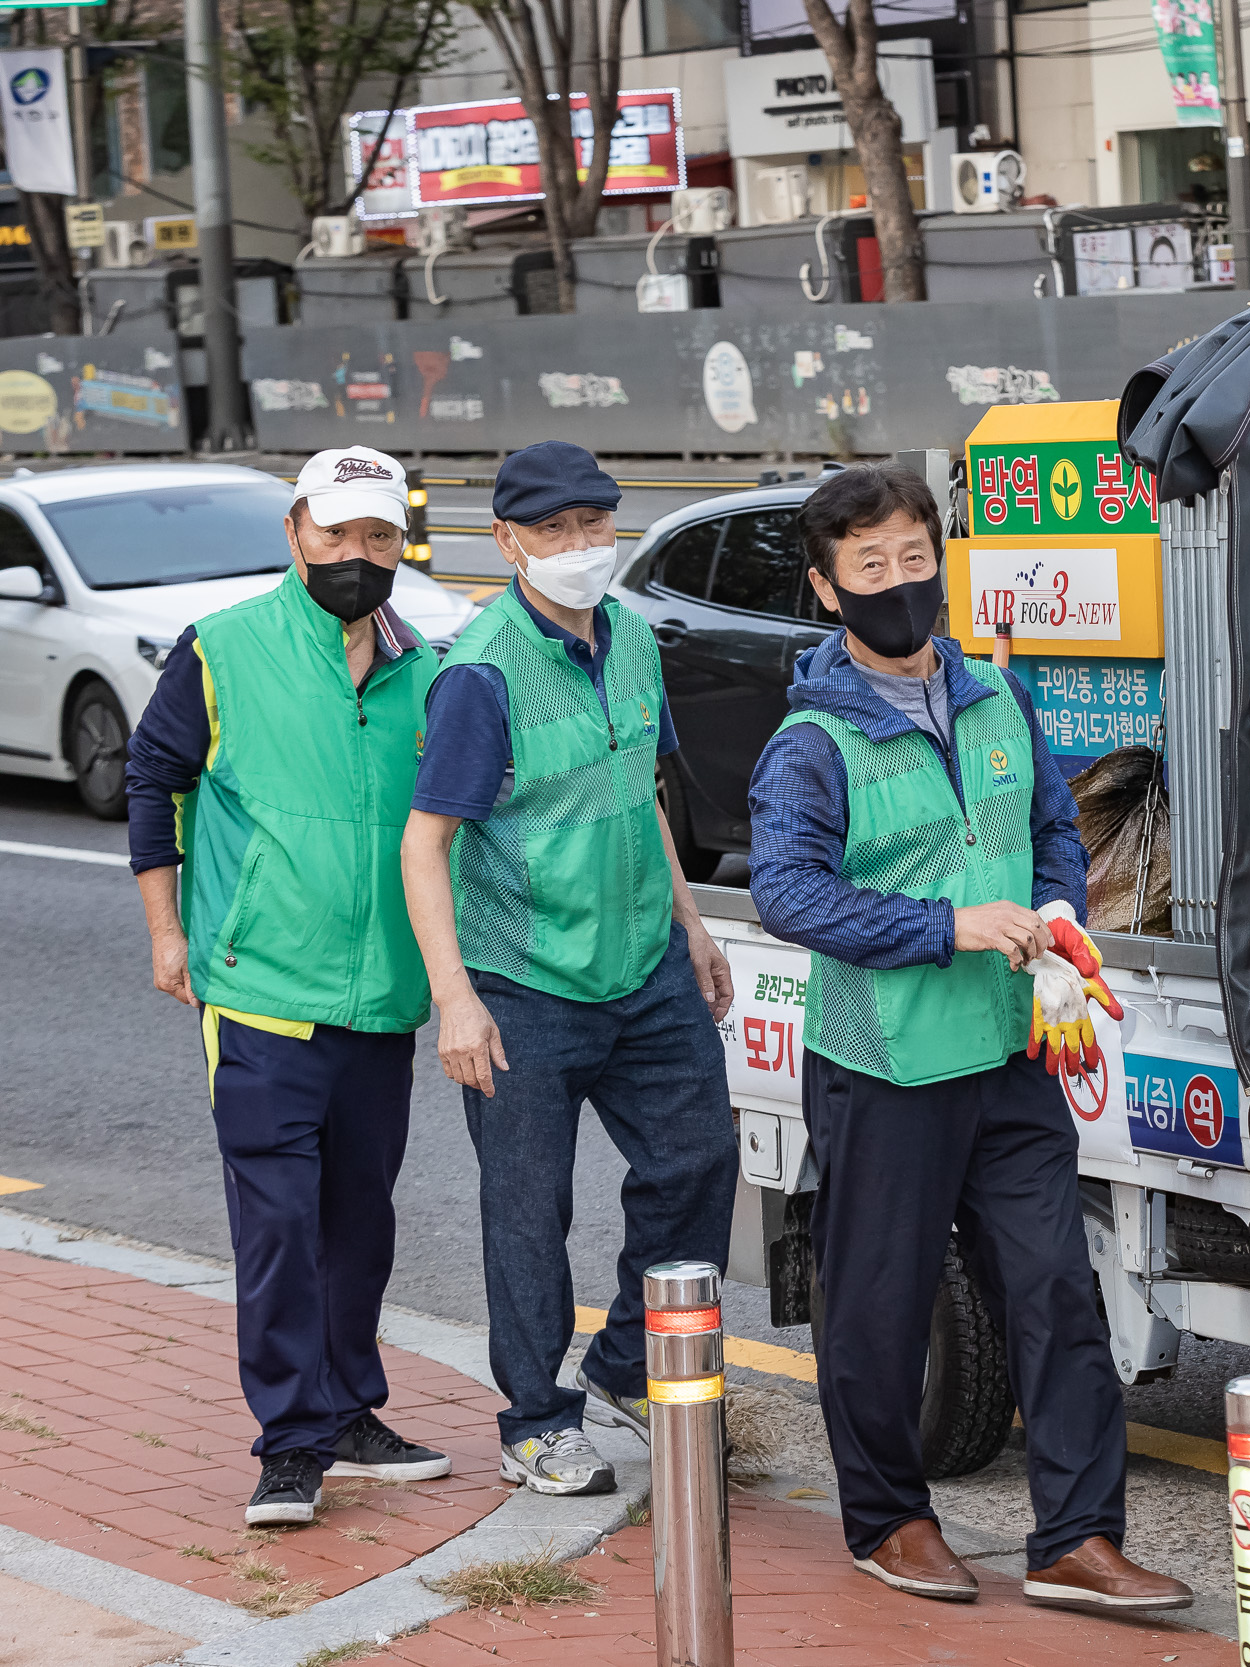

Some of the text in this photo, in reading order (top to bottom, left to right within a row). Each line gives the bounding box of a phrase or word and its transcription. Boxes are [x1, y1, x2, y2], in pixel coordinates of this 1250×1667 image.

[335, 458, 373, 475] White
[978, 455, 1041, 525] 방역
[975, 589, 1015, 626] AIR
[1037, 665, 1149, 707] 구의2동, 광장동
[993, 773, 1018, 787] SMU
[743, 1016, 796, 1079] 모기
[1189, 1088, 1216, 1141] 역
